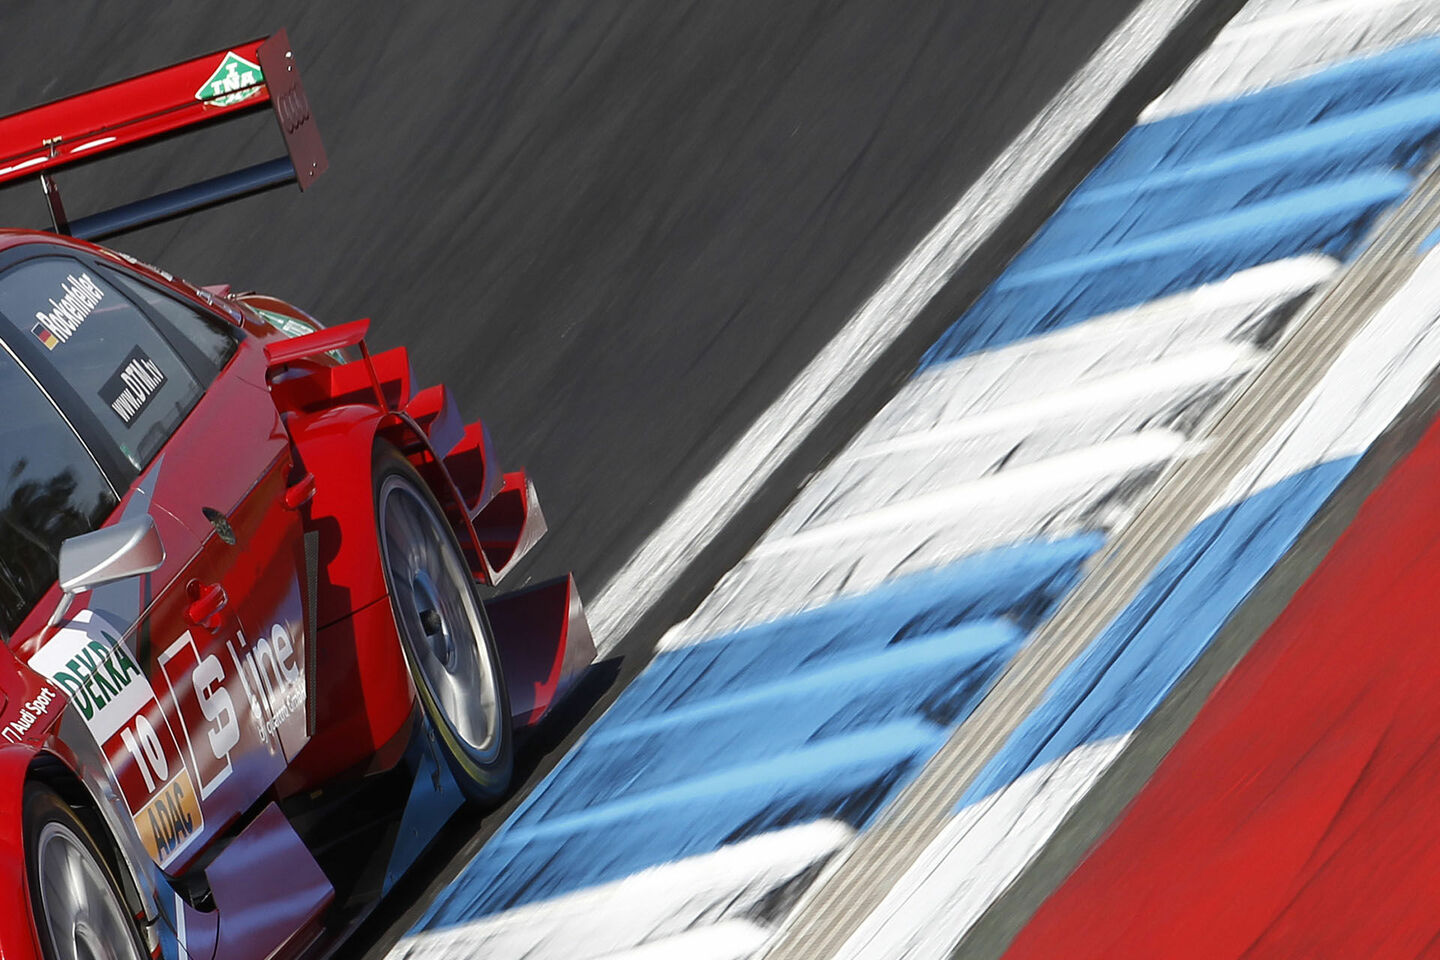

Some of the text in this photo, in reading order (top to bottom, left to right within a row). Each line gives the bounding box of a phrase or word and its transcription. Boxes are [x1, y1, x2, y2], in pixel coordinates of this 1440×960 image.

[111, 359, 165, 423] www.DTM.tv
[10, 687, 56, 736] Audi Sport
[53, 630, 140, 722] DEKRA
[124, 714, 169, 794] 10
[146, 780, 194, 862] ADAC
